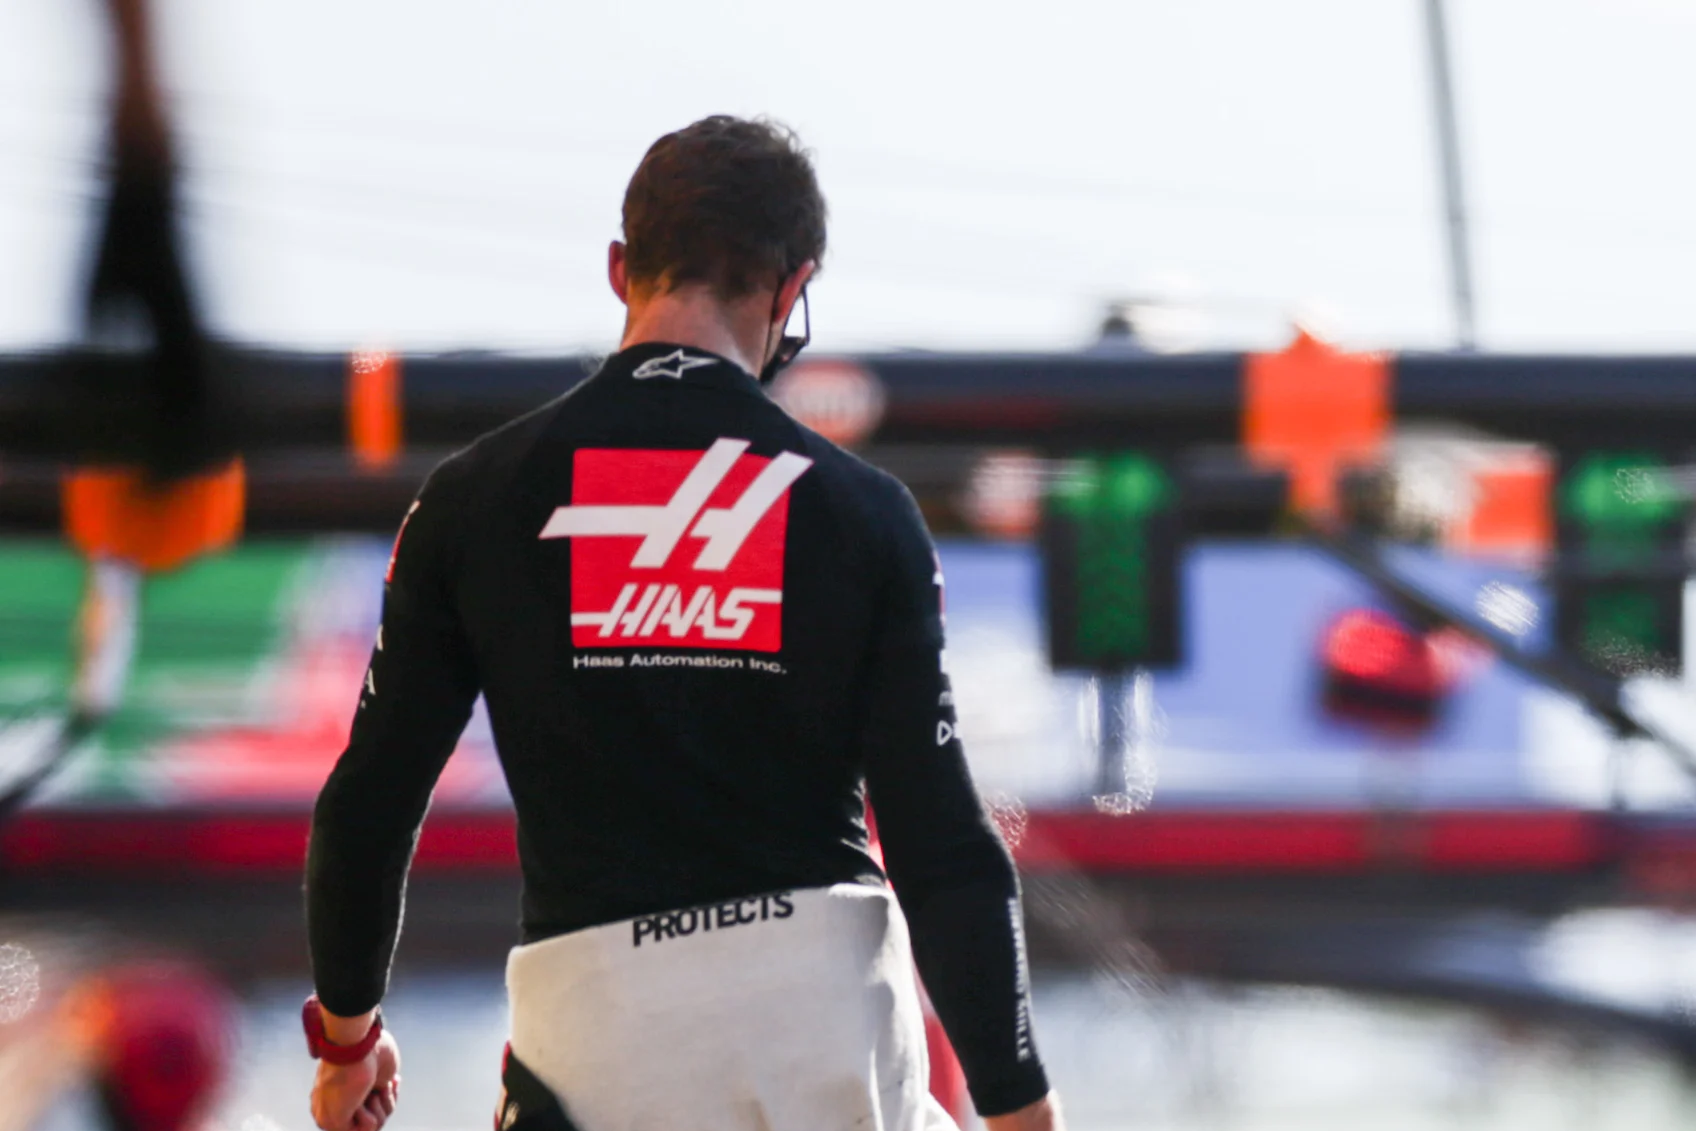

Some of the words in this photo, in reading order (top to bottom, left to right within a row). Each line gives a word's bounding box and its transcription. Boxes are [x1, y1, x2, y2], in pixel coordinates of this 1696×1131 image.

[571, 583, 783, 640] HAAS
[573, 653, 624, 669] Haas
[630, 653, 743, 669] Automation
[748, 657, 787, 675] Inc.
[632, 891, 794, 947] PROTECTS
